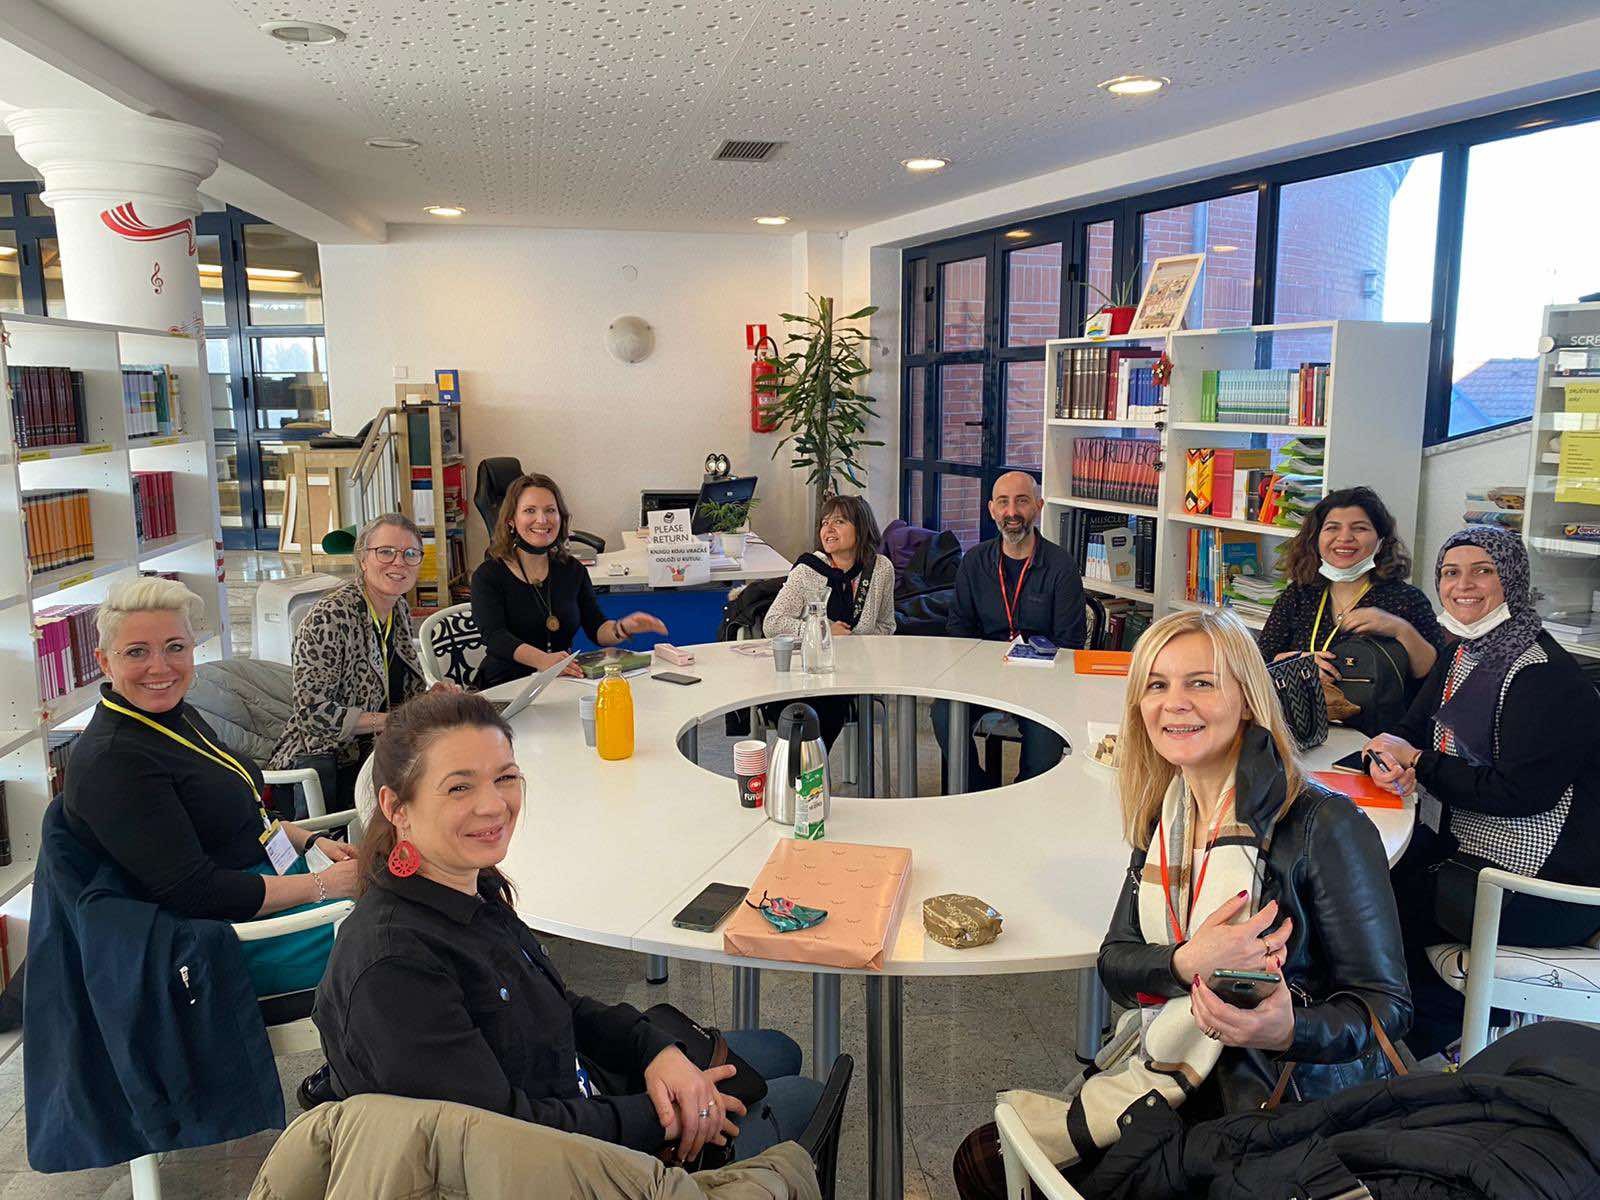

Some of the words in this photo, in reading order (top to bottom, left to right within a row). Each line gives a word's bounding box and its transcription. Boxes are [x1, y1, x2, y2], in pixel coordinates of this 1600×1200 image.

[1073, 439, 1133, 464] WORLD
[654, 525, 684, 533] PLEASE
[653, 534, 689, 543] RETURN
